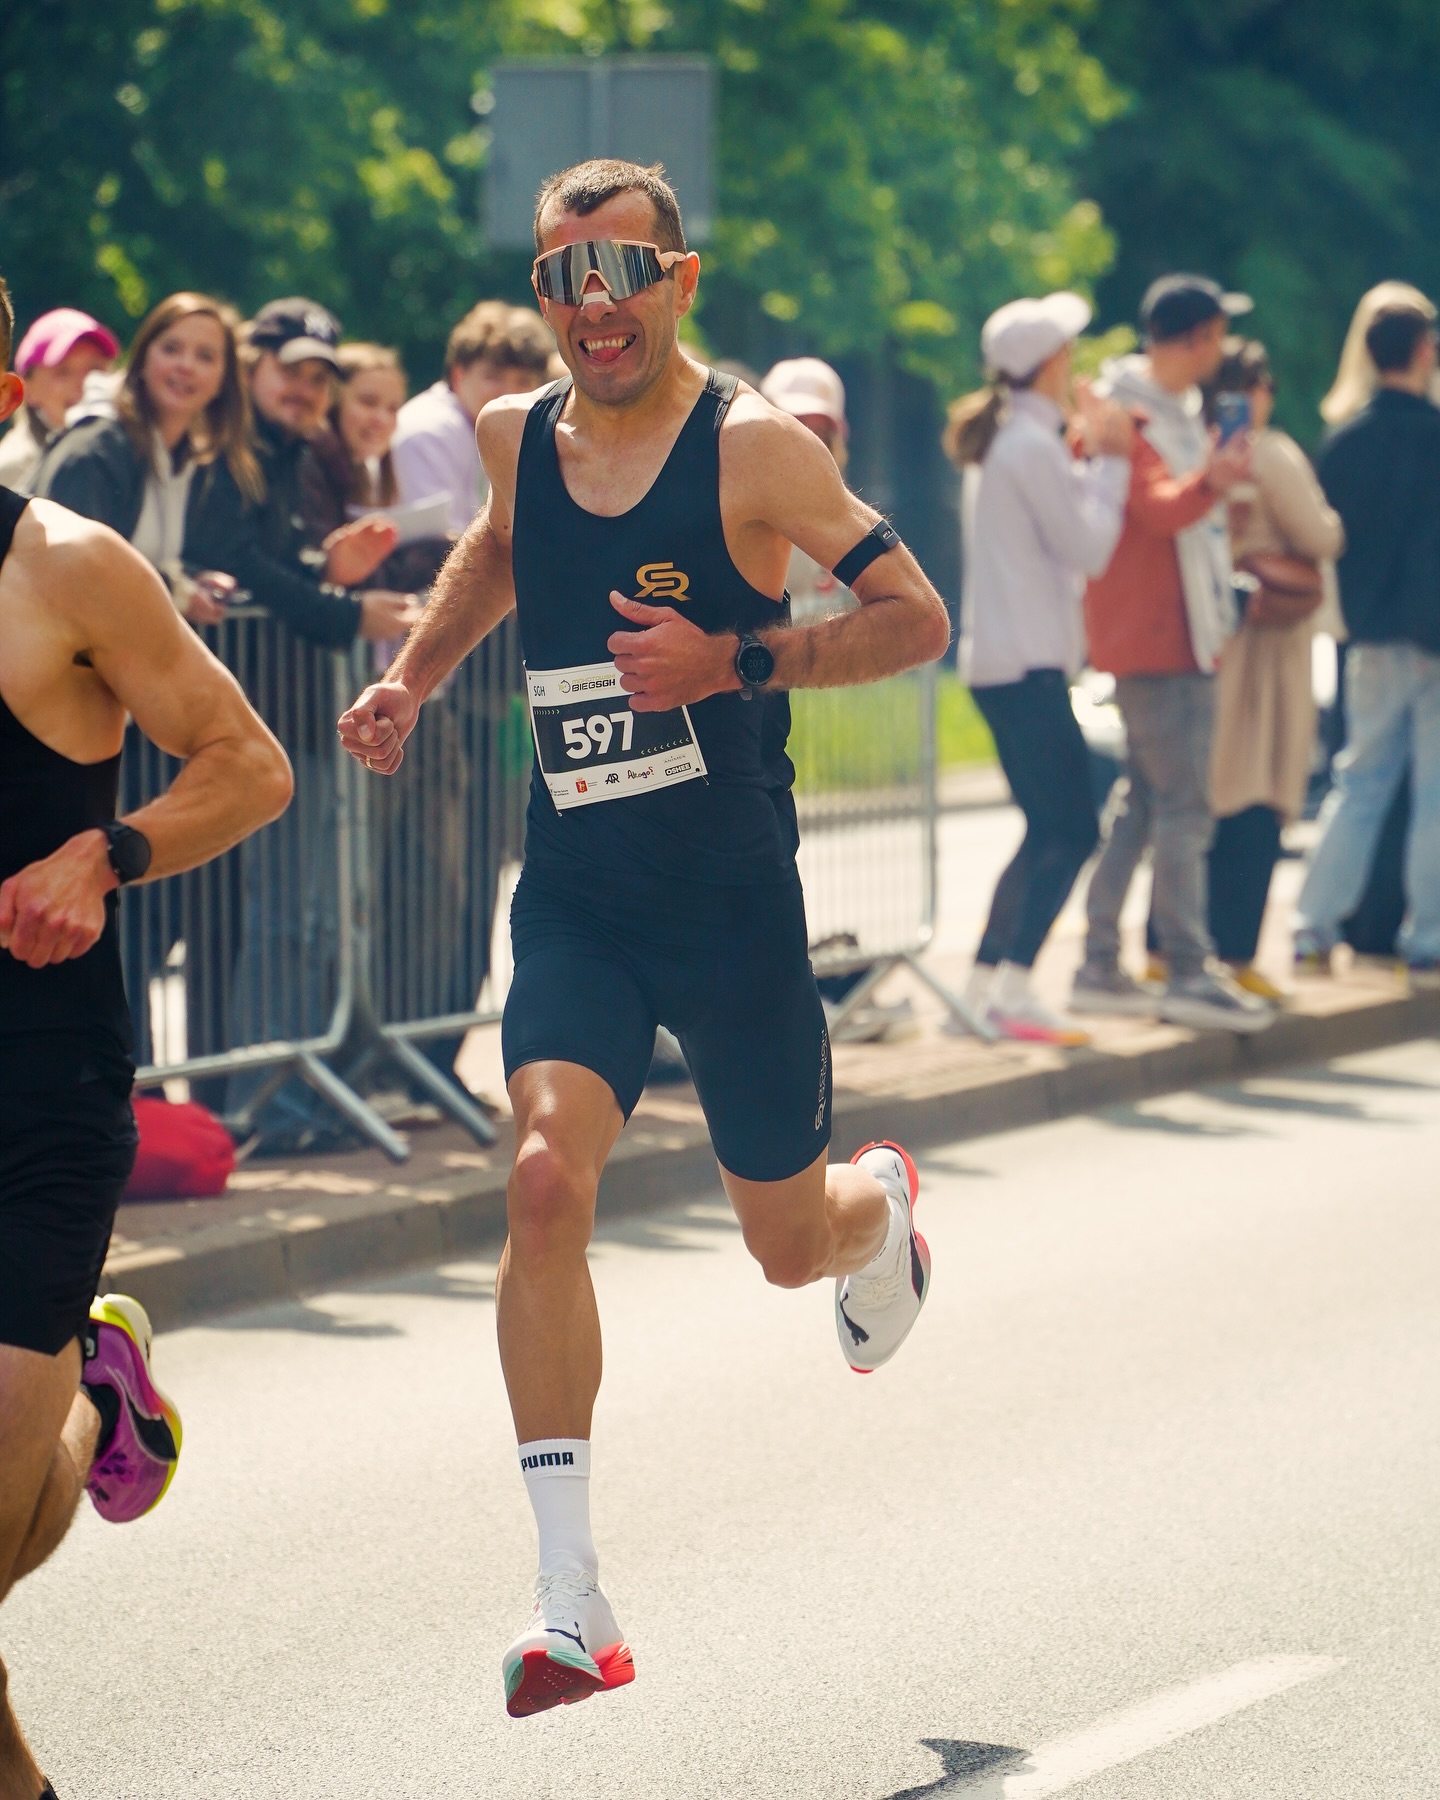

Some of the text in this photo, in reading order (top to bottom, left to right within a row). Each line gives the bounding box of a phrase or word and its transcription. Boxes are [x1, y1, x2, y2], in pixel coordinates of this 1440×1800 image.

[533, 685, 546, 696] SGH
[562, 711, 634, 759] 597
[666, 763, 690, 775] OSHEE
[521, 1452, 574, 1472] PUMA
